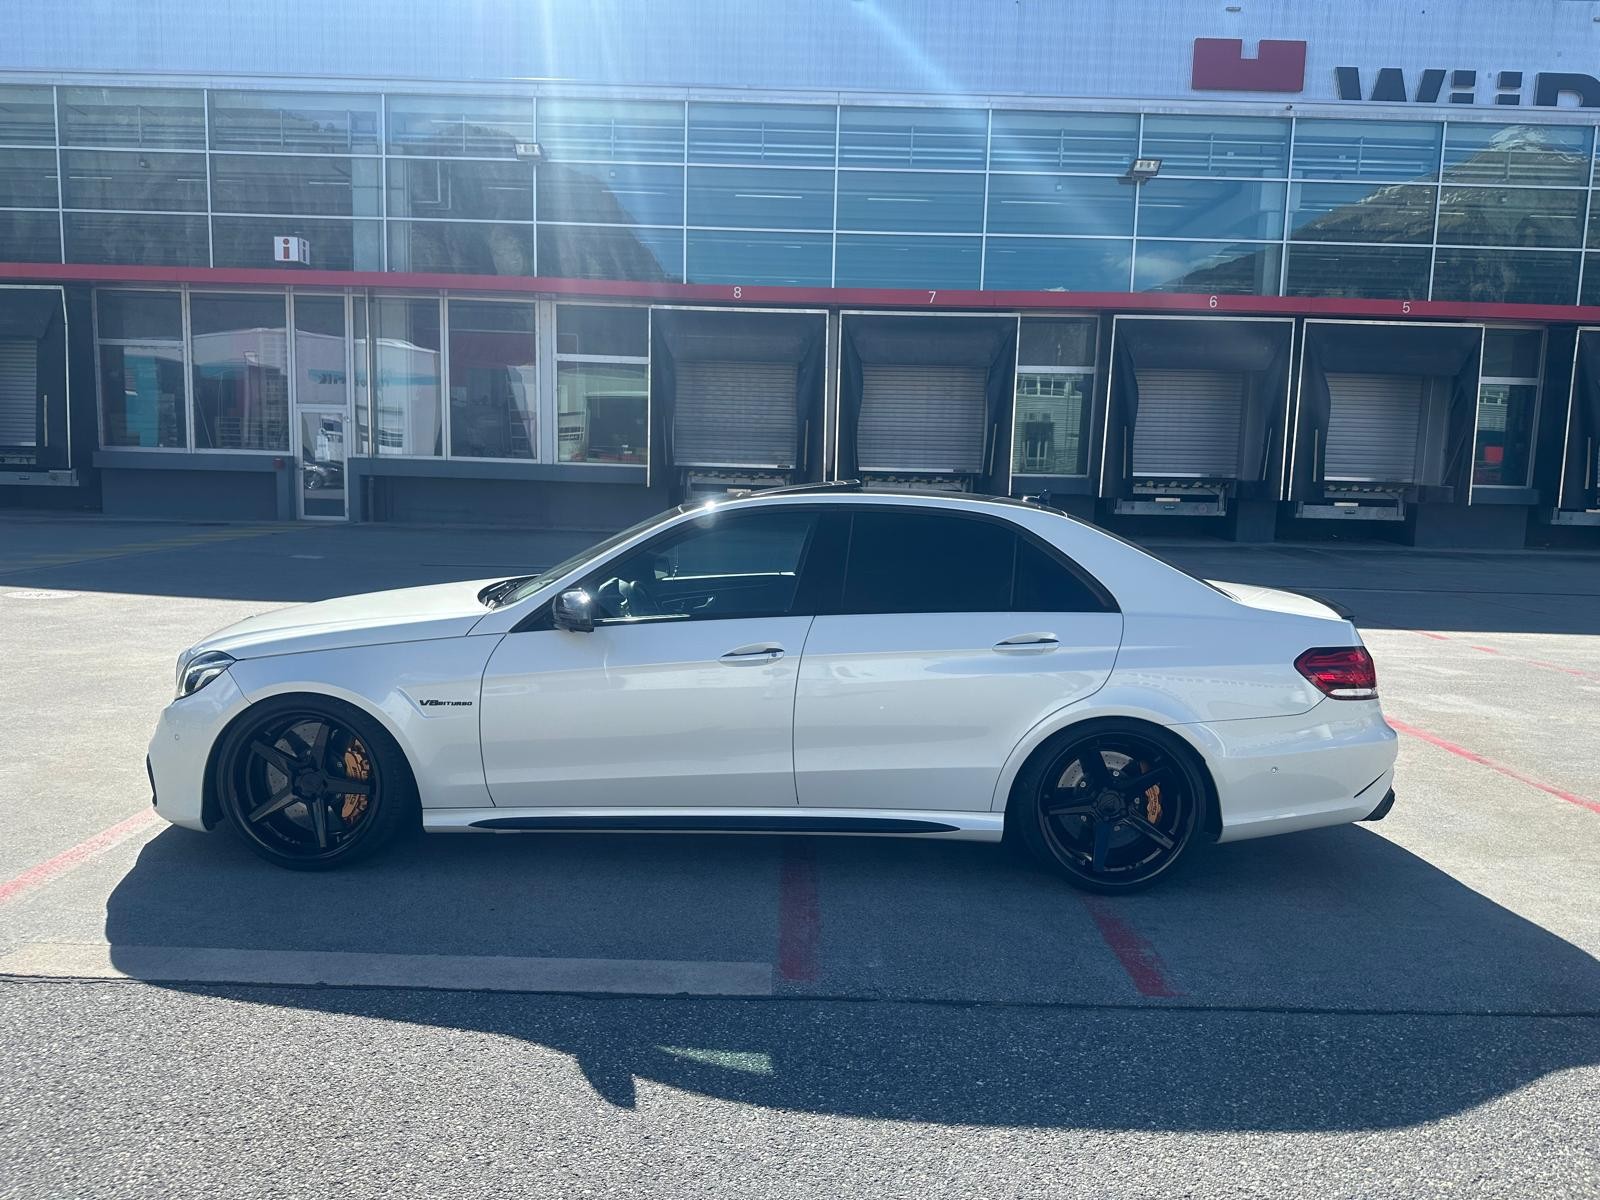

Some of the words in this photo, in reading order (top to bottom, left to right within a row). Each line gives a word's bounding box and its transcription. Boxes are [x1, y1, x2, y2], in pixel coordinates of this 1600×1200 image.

[733, 286, 742, 299] 8
[928, 290, 937, 304] 7
[1209, 295, 1218, 309] 6
[1402, 301, 1411, 314] 5
